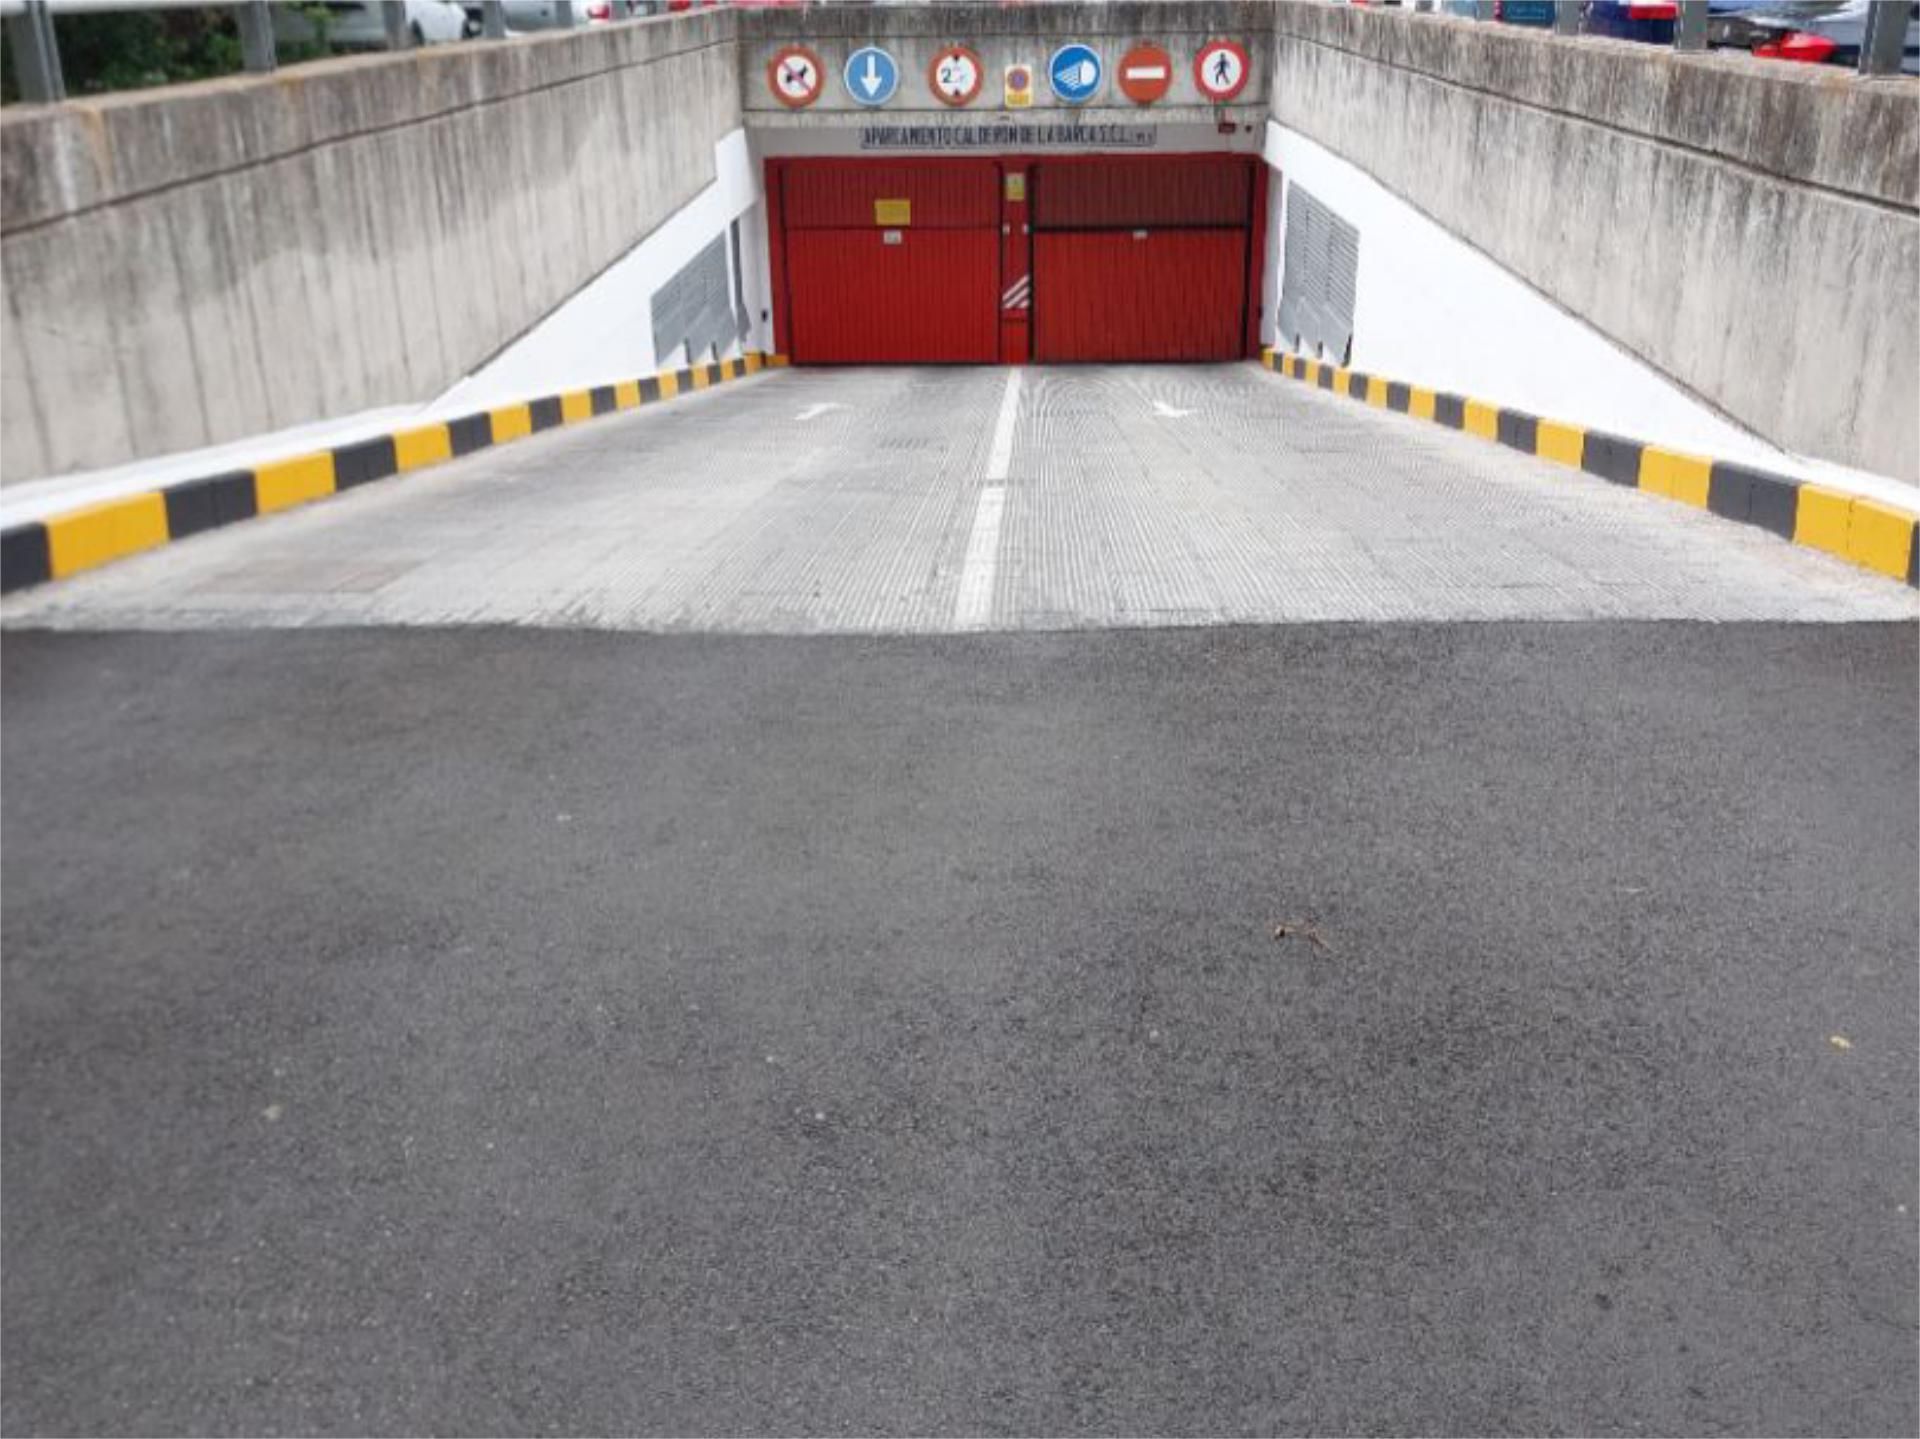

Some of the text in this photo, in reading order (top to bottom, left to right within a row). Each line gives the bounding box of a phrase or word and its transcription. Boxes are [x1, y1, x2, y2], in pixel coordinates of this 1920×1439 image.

[1019, 125, 1034, 144] DE
[1037, 125, 1053, 144] LA
[1057, 125, 1096, 143] BARCA
